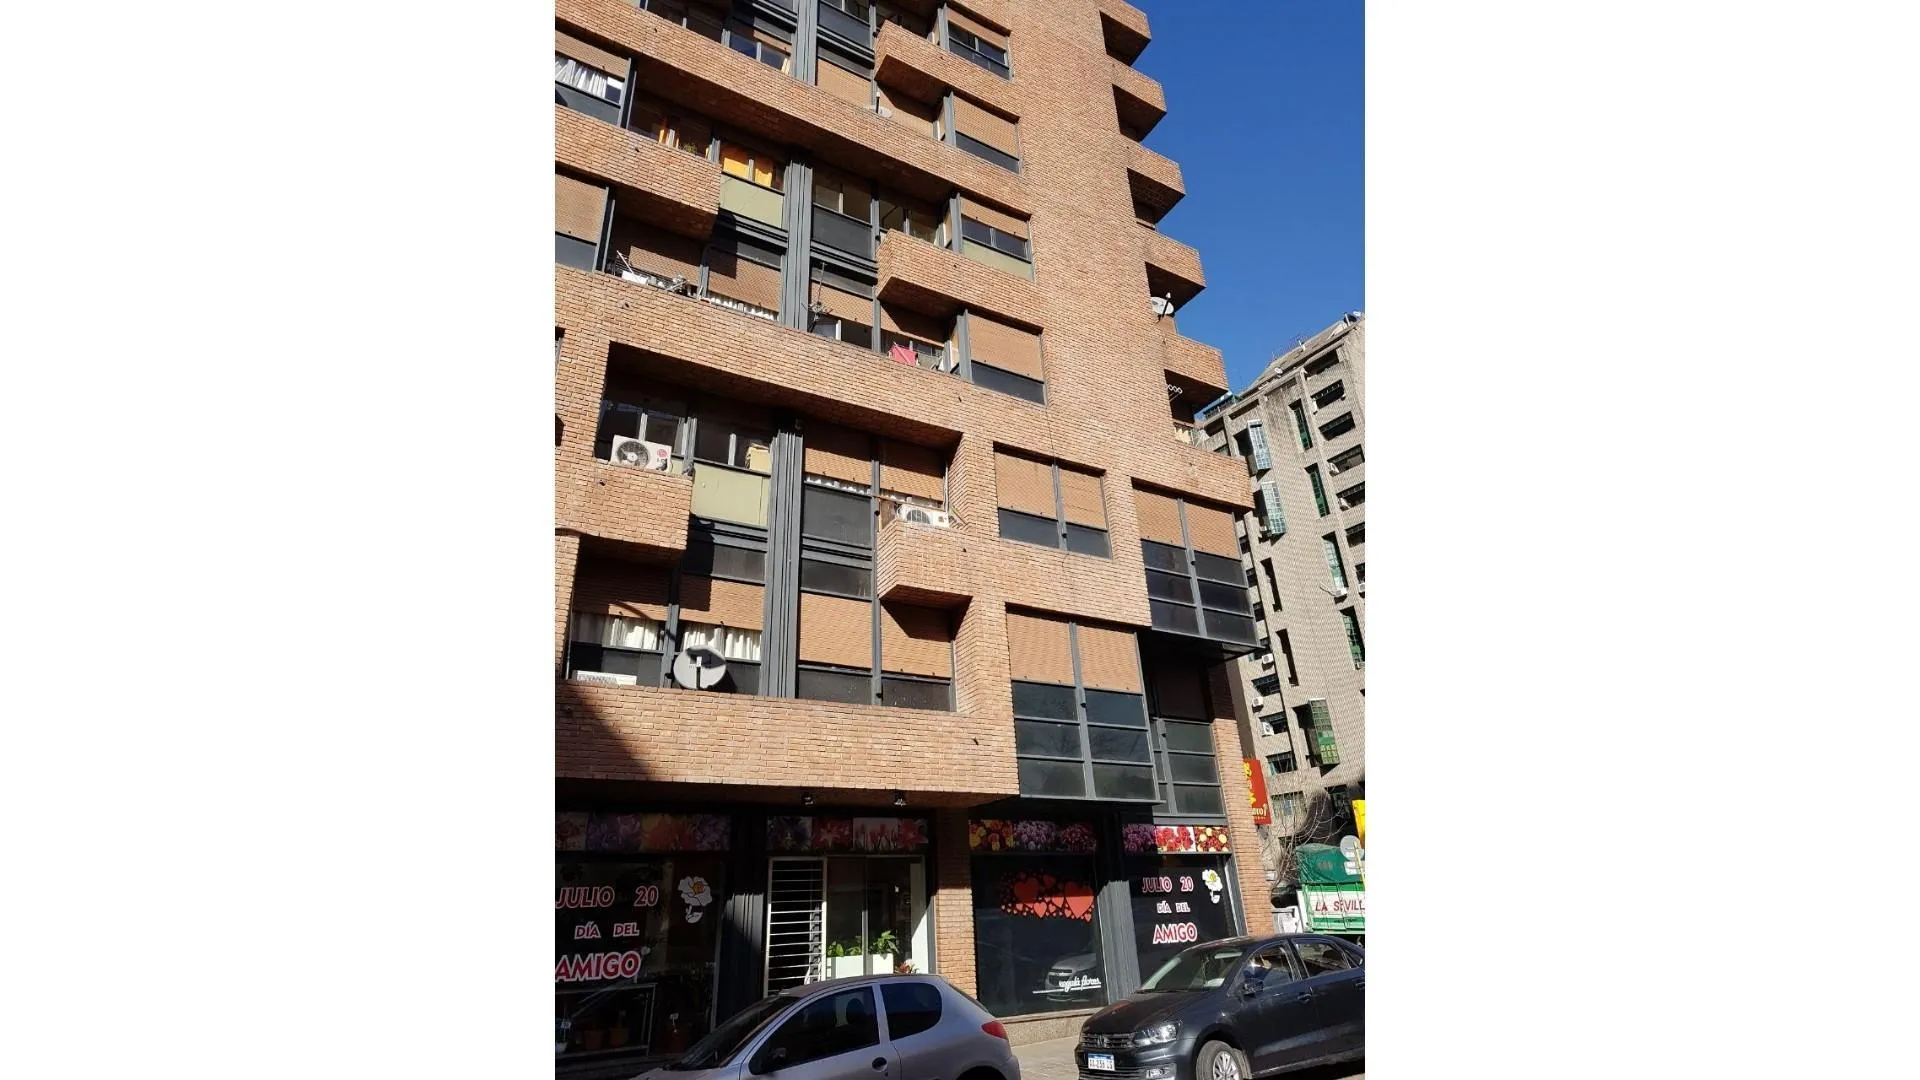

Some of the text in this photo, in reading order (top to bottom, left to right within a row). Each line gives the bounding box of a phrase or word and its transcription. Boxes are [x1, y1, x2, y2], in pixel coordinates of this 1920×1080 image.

[1142, 876, 1194, 893] JULIO 20
[555, 885, 659, 909] JULIO 20
[1157, 900, 1191, 913] DÍA DEL
[1315, 901, 1328, 912] LA
[574, 921, 640, 939] DÍA DEL
[1152, 922, 1198, 944] AMIGO
[555, 951, 641, 982] AMIGO
